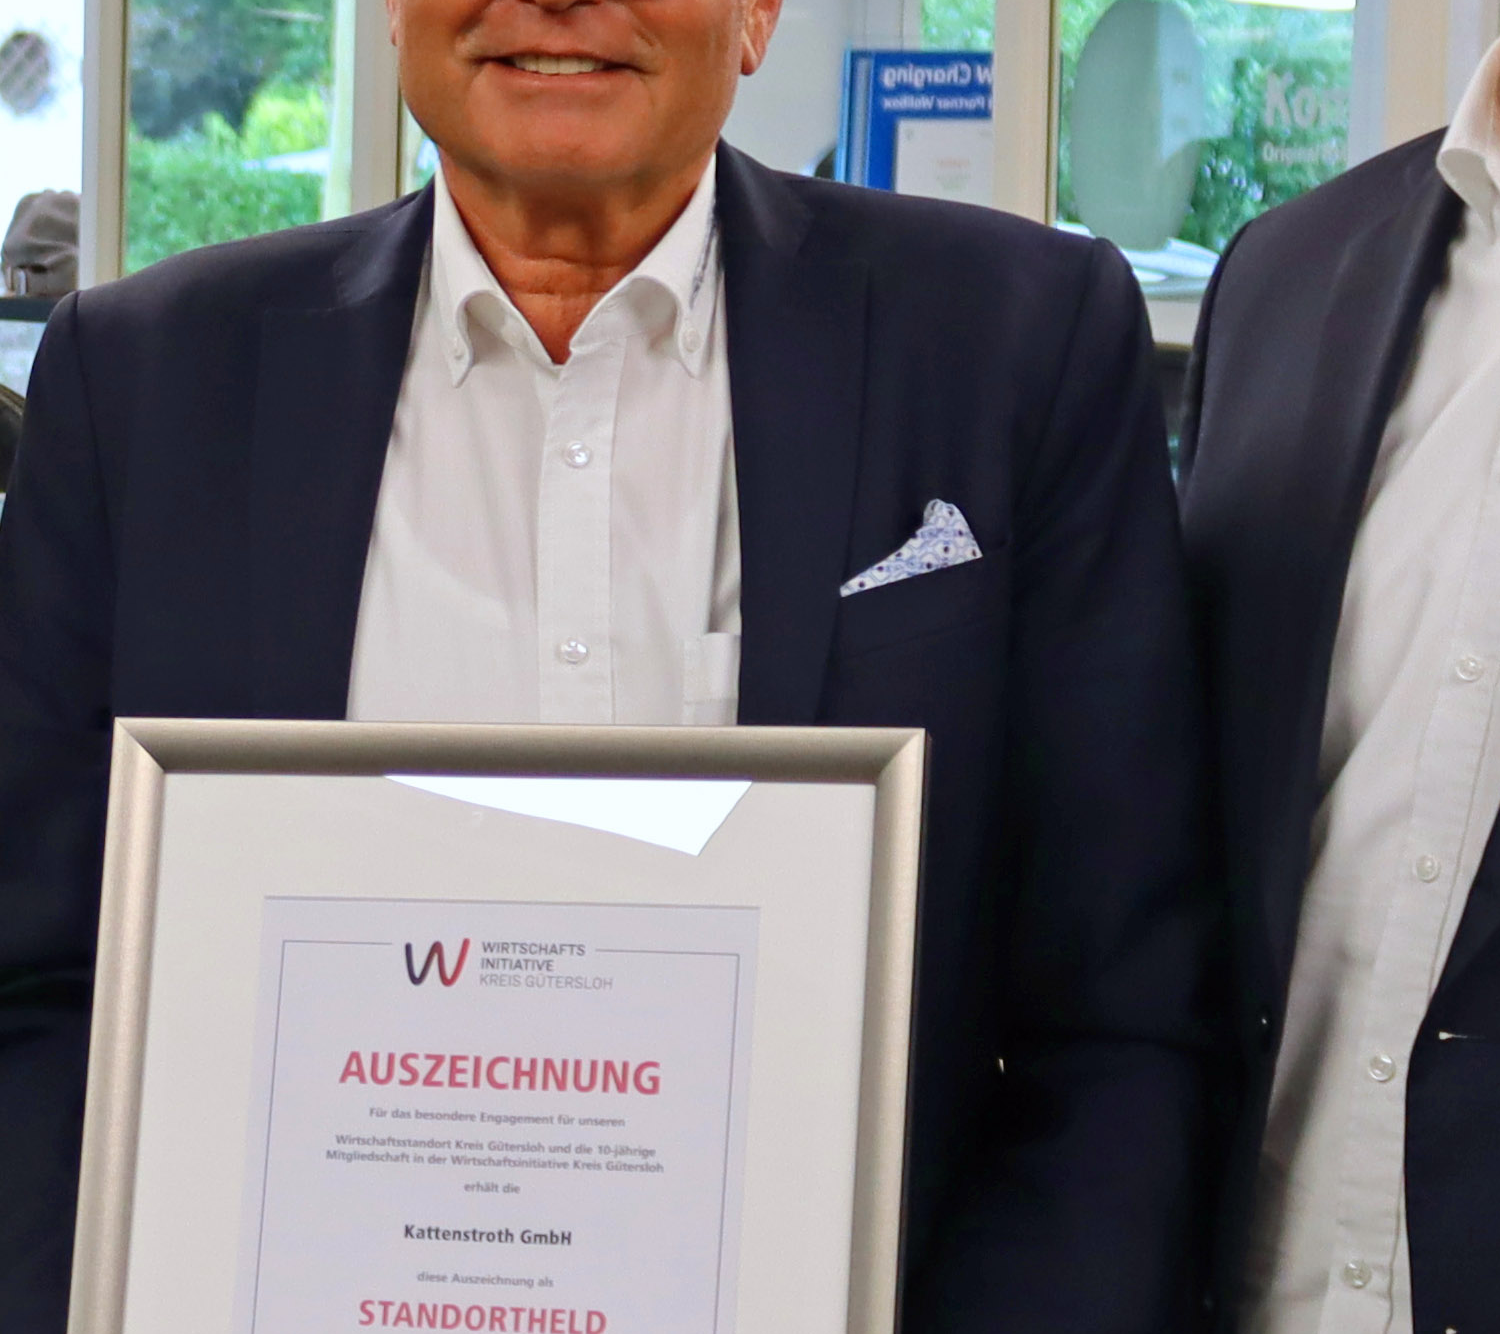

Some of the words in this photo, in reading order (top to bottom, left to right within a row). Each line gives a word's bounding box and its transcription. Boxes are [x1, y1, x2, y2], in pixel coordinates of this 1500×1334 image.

[482, 941, 586, 956] WIRTSCHAFTS
[481, 958, 554, 972] INITIATIVE
[479, 974, 521, 988] KREIS
[526, 974, 613, 990] GÜTERSLOH
[339, 1051, 661, 1095] AUSZEICHNUNG
[369, 1107, 387, 1118] Für
[391, 1108, 411, 1119] das
[415, 1109, 476, 1122] besondere
[480, 1112, 554, 1125] Engagement
[558, 1114, 575, 1125] für
[578, 1117, 625, 1127] unseren
[335, 1134, 451, 1149] Wirtschaftsstandort
[455, 1139, 484, 1151] Kreis
[488, 1140, 544, 1153] Gütersloh
[549, 1143, 572, 1154] und
[575, 1144, 593, 1155] die
[598, 1145, 655, 1158] 10-jährige
[326, 1150, 409, 1164] Mitgliedschaft
[413, 1153, 424, 1163] in
[427, 1153, 447, 1165] der
[451, 1155, 569, 1170] Wirtschaftsinitiative
[573, 1159, 602, 1171] Kreis
[606, 1161, 664, 1174] Gütersloh
[464, 1181, 499, 1193] erhält
[502, 1183, 520, 1194] die
[404, 1224, 514, 1244] Kattenstroth
[520, 1230, 572, 1245] GmbH
[418, 1271, 448, 1283] diese
[452, 1273, 534, 1288] Auszeichnung
[538, 1276, 554, 1288] als
